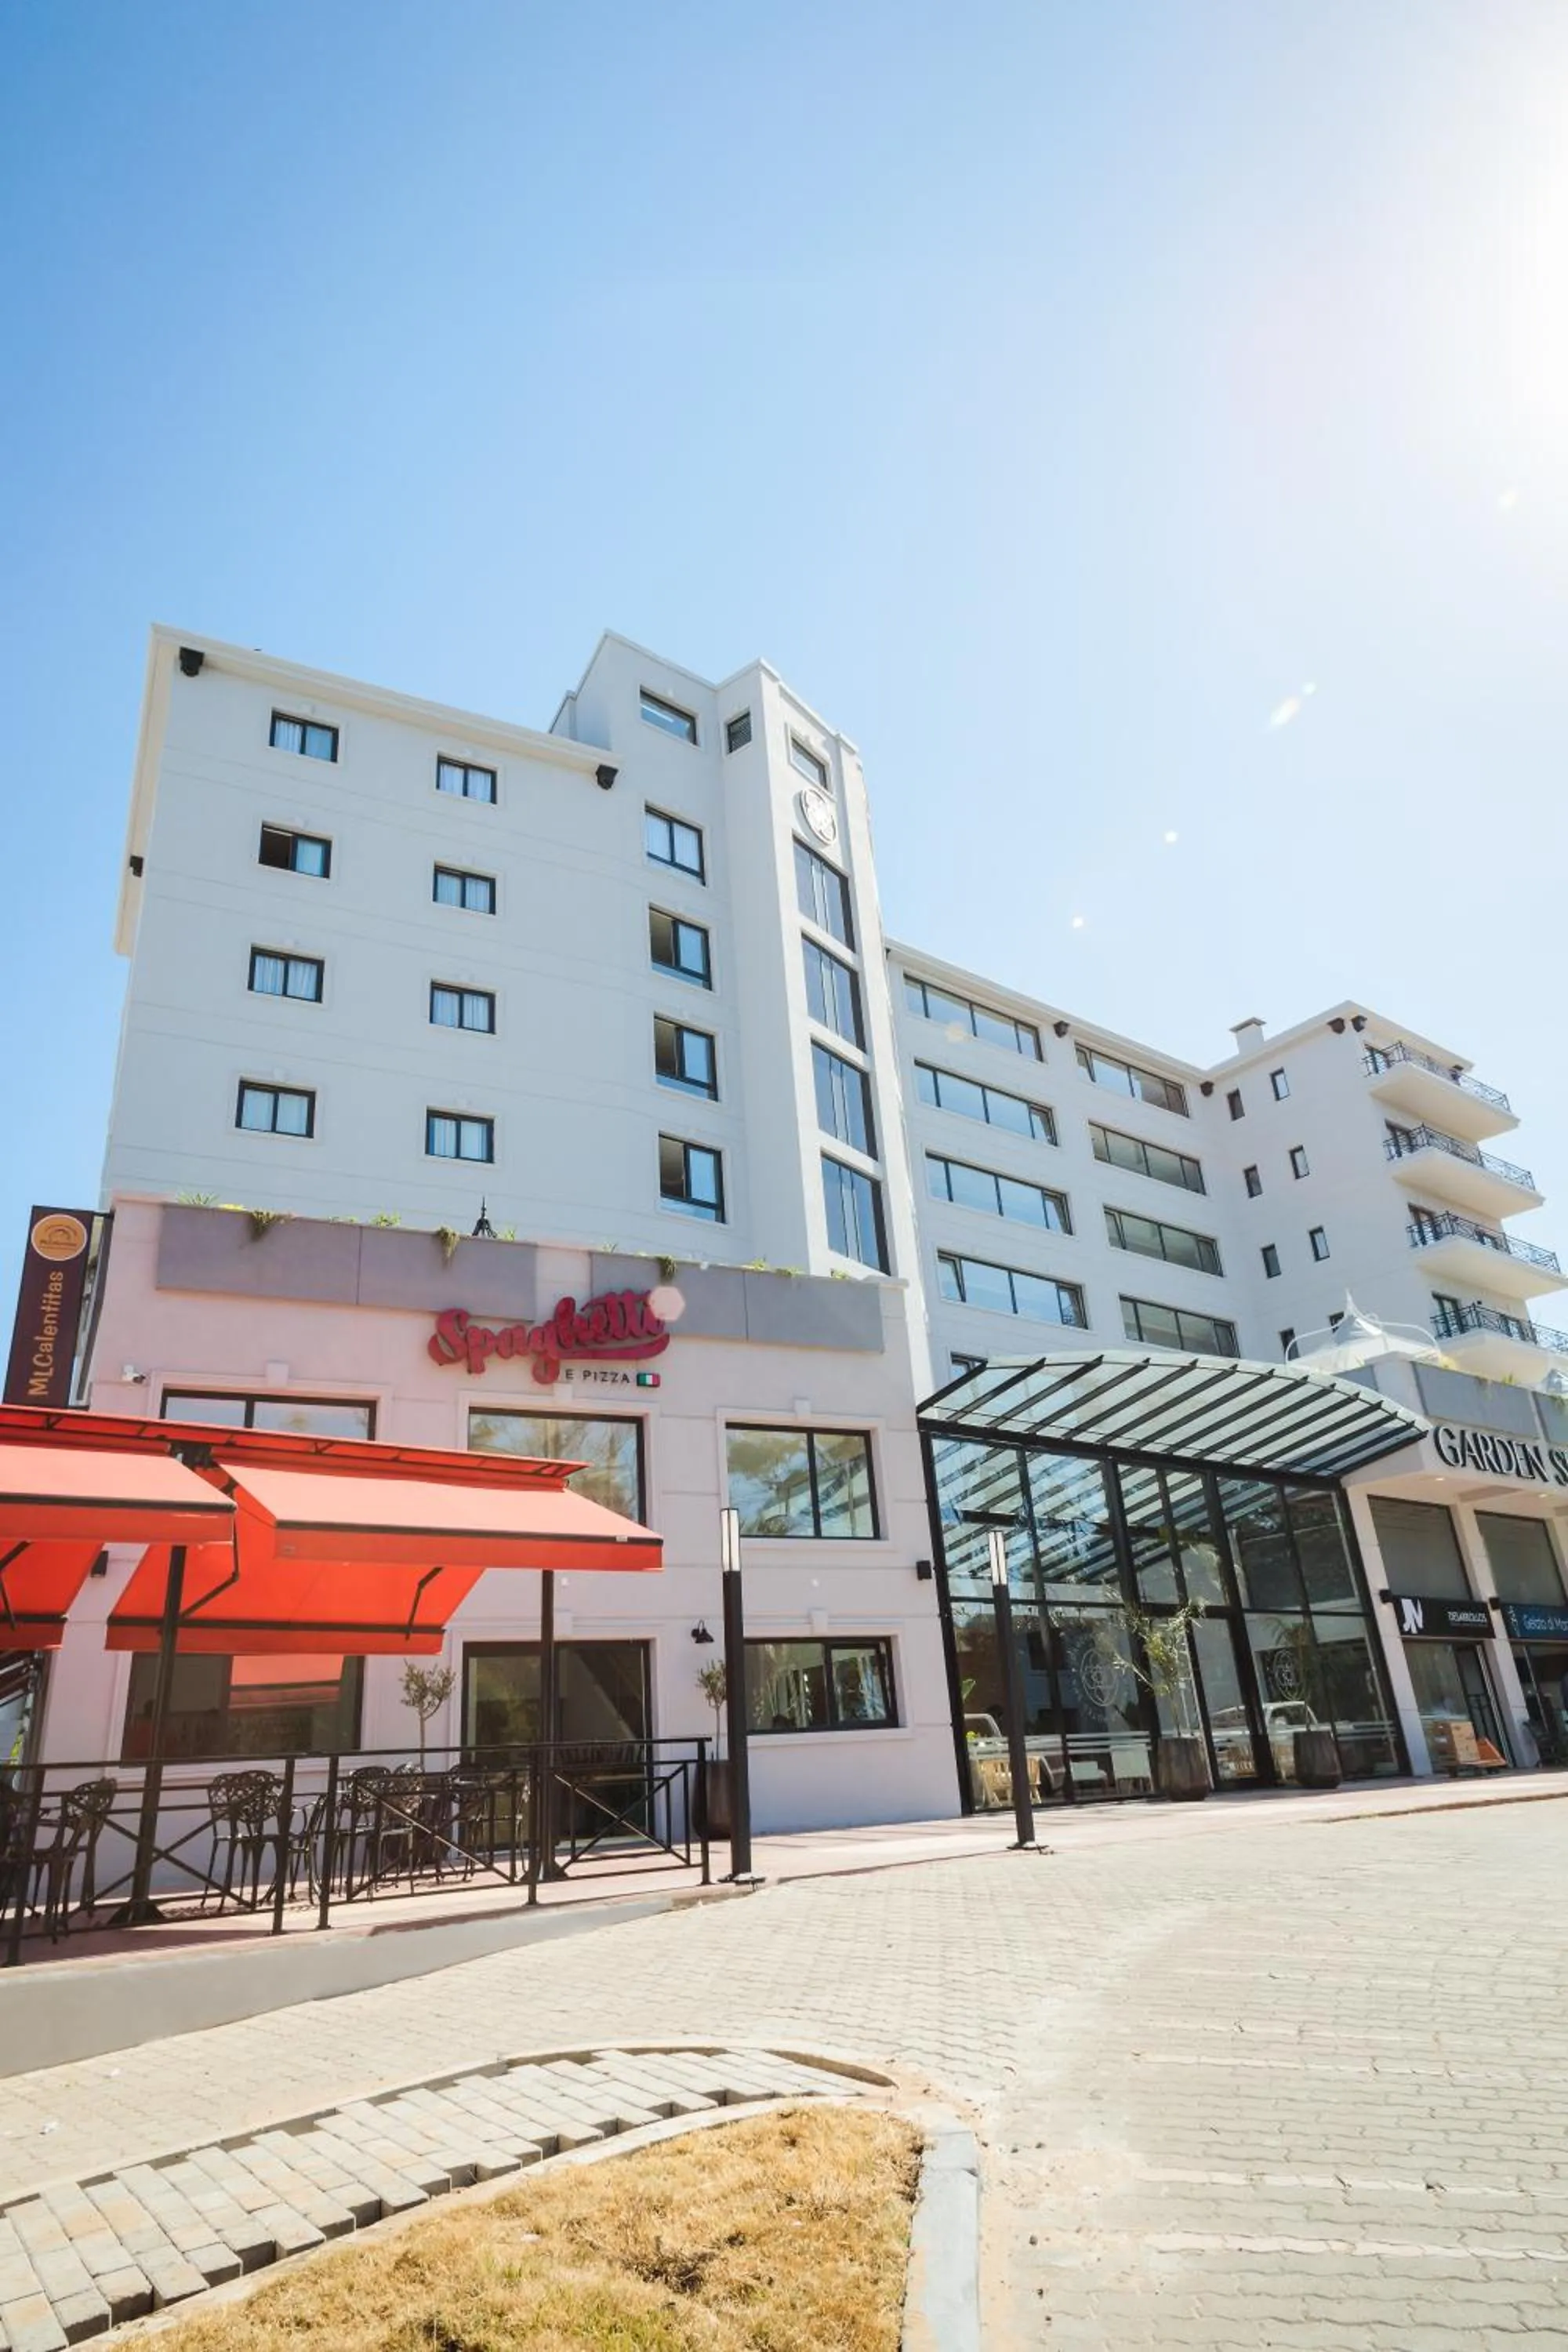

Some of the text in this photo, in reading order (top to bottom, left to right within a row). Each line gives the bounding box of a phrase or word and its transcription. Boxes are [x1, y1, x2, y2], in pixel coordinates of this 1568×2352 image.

[27, 1270, 64, 1396] MLCalentitas
[565, 1368, 630, 1384] E PIZZA
[1433, 1425, 1549, 1483] GARDEN
